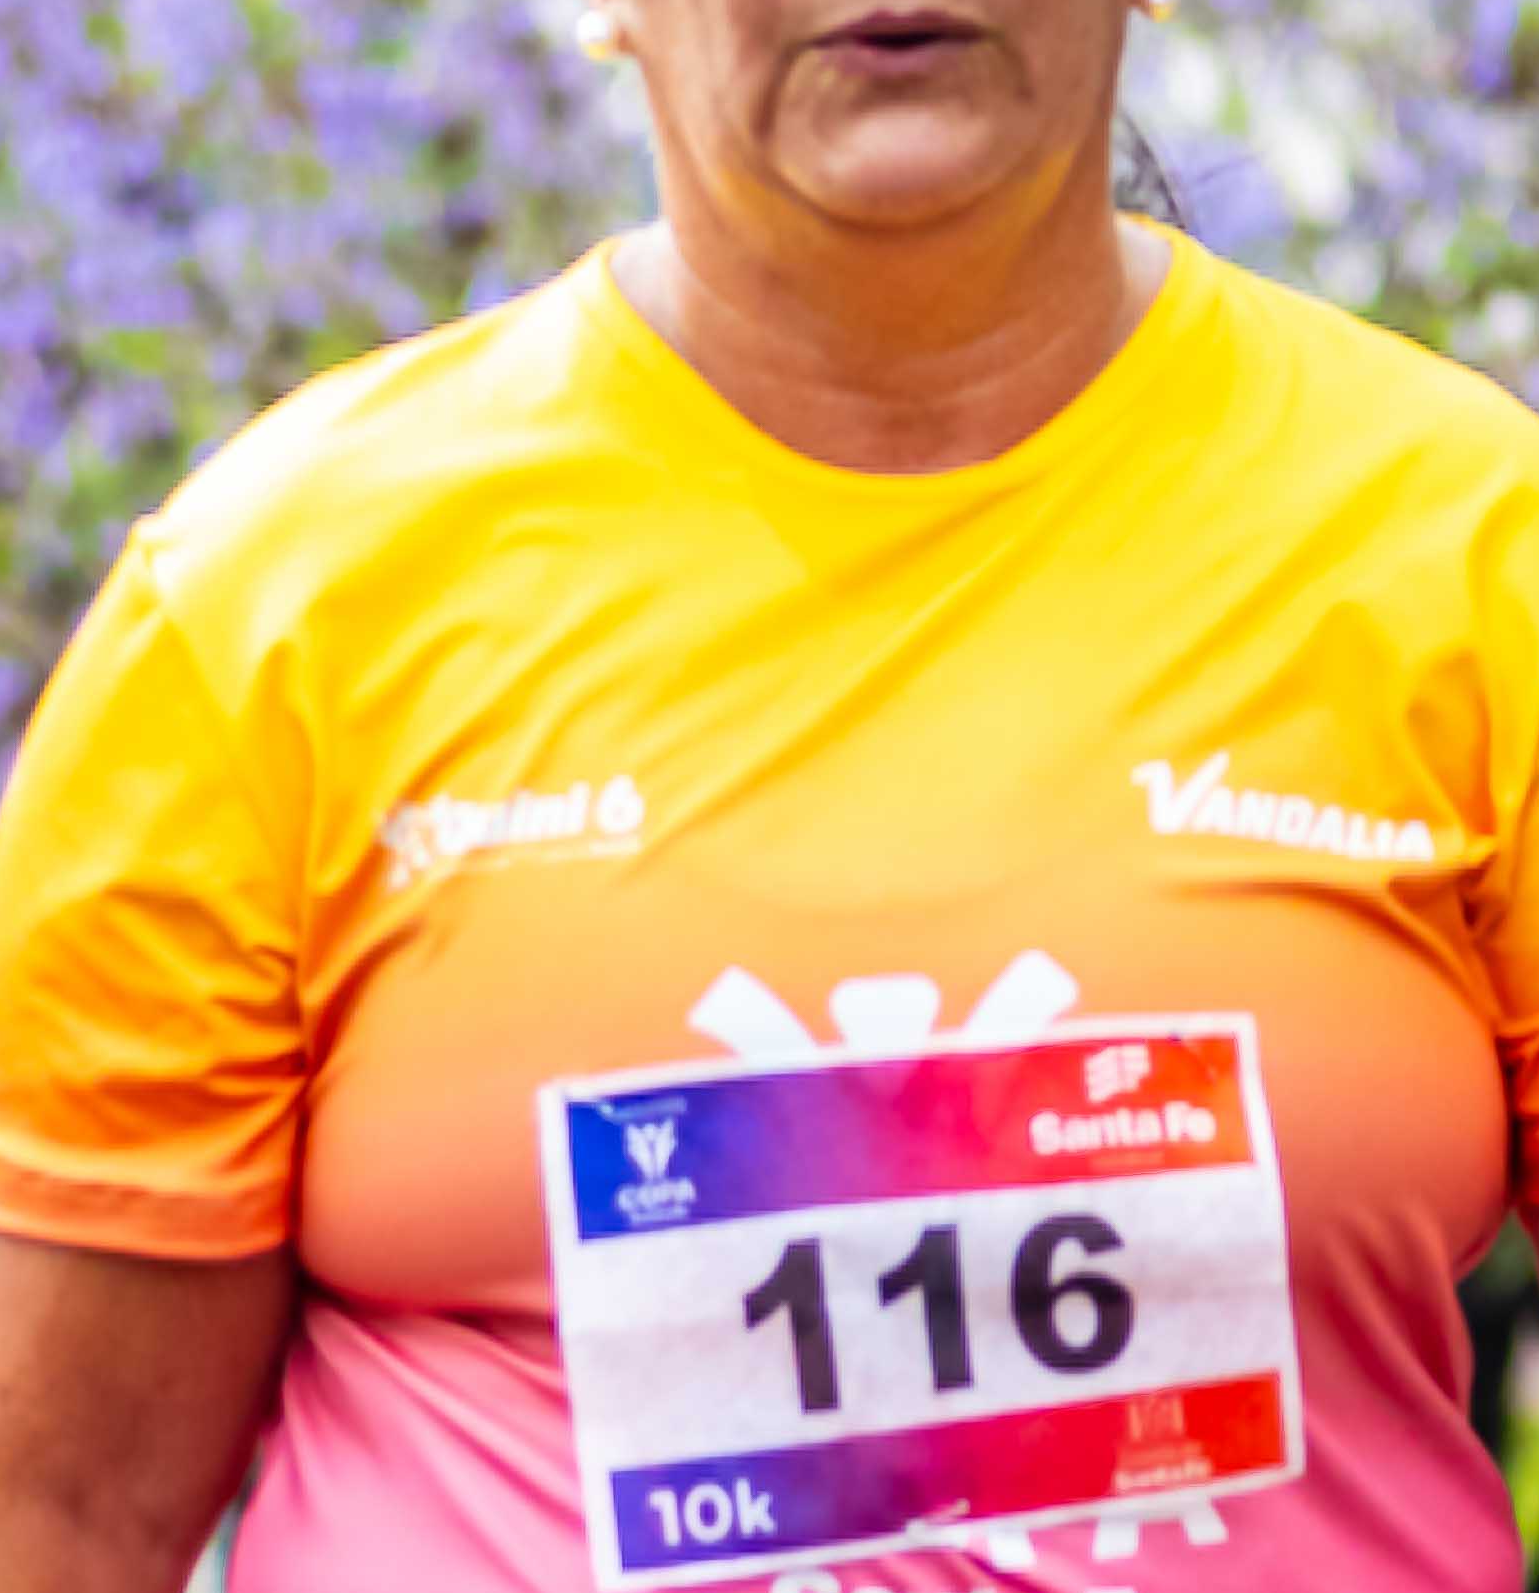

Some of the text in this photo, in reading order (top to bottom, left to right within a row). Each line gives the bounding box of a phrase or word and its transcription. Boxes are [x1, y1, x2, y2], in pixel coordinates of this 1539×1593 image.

[1028, 1100, 1217, 1157] Santa Fe
[744, 1213, 1135, 1415] 116
[648, 1476, 777, 1548] 10k
